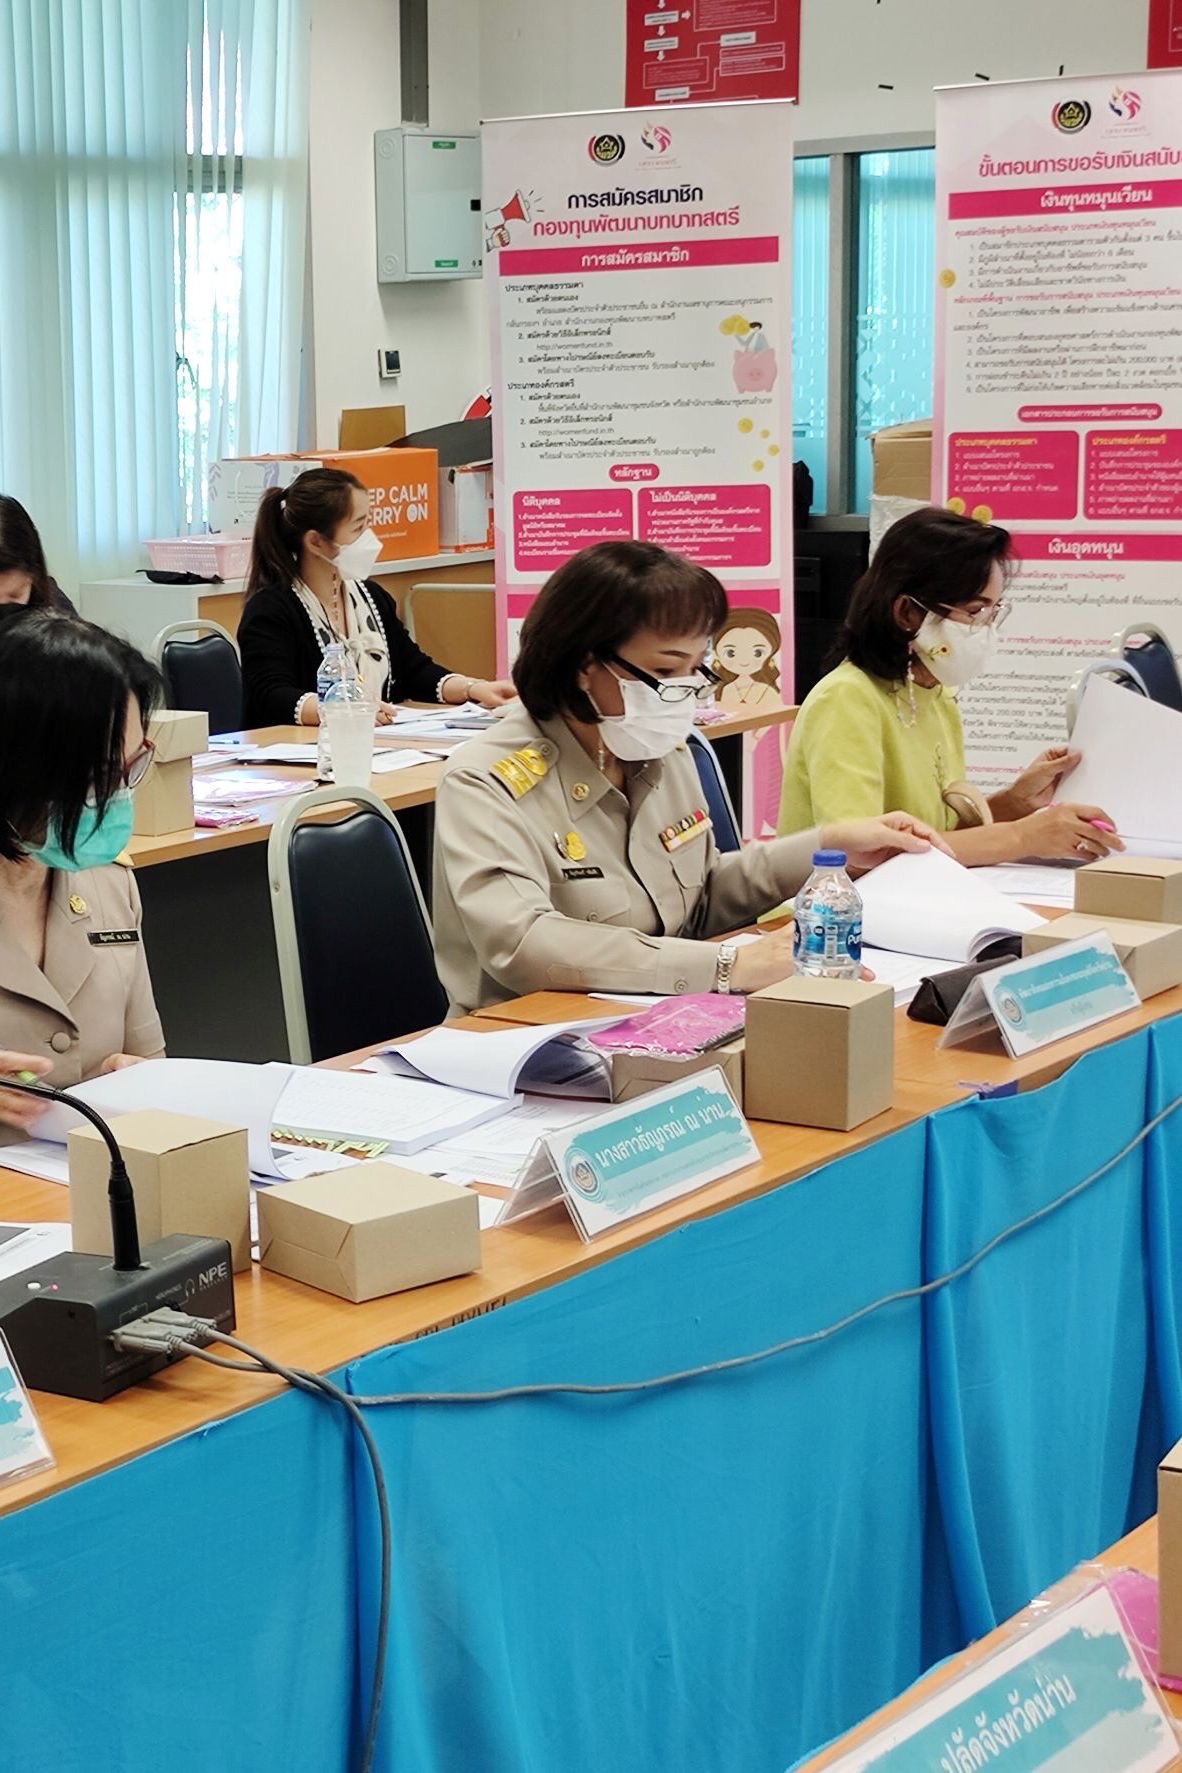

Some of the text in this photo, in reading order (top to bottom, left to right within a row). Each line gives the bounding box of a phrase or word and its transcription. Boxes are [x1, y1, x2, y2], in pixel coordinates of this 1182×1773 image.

[979, 147, 1182, 177] ขั้นตอนการขอรับเงินสนับ
[567, 184, 703, 209] การสมัครสมาชิก
[1040, 186, 1153, 211] เงินทุนหมุนเวียน
[533, 206, 740, 238] กองทุนพัฒนาบทบาทสตรี
[581, 246, 690, 267] การสมัครสมาชิก
[389, 483, 428, 504] CALM
[406, 502, 428, 523] ON
[1048, 538, 1124, 559] เงินอุดหนุน
[198, 1262, 228, 1287] NPE
[940, 1673, 1077, 1773] ปลัดจังหวัดน่าน
